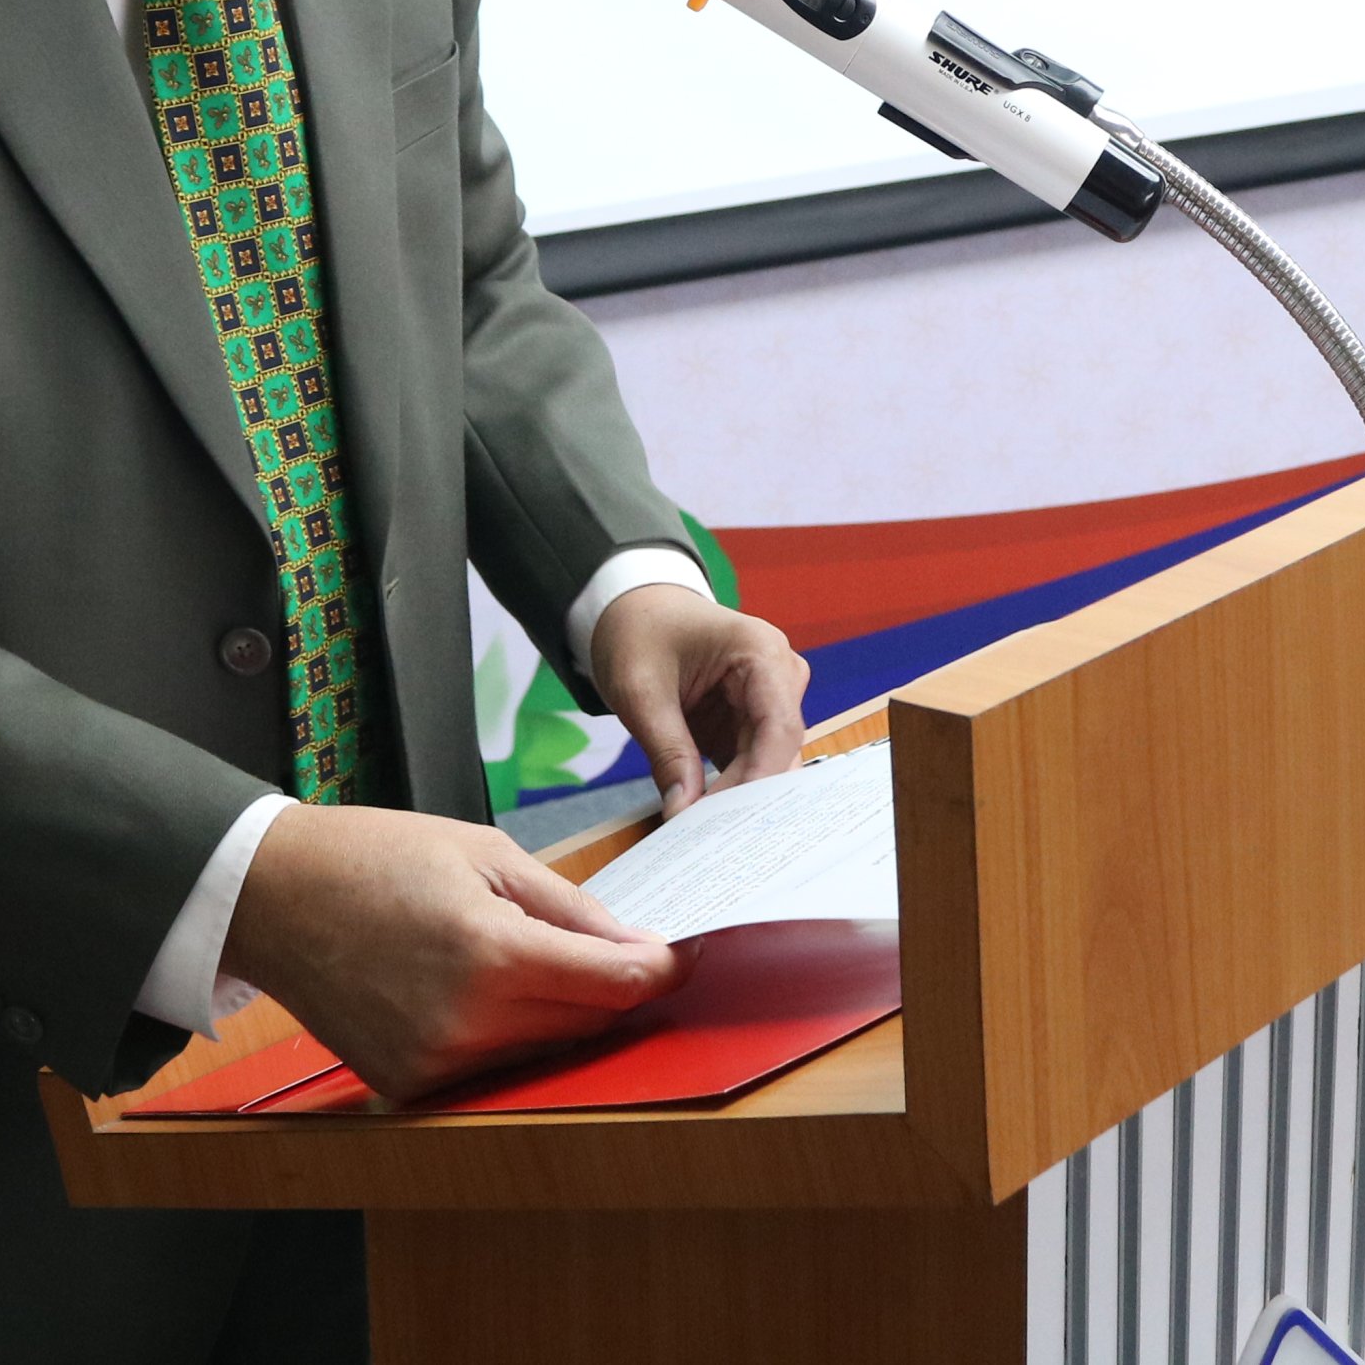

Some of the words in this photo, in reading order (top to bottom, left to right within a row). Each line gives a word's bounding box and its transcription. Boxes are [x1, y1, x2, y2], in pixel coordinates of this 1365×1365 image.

[928, 50, 994, 96] SHURE
[1002, 99, 1025, 119] UGX
[1024, 114, 1032, 123] 8
